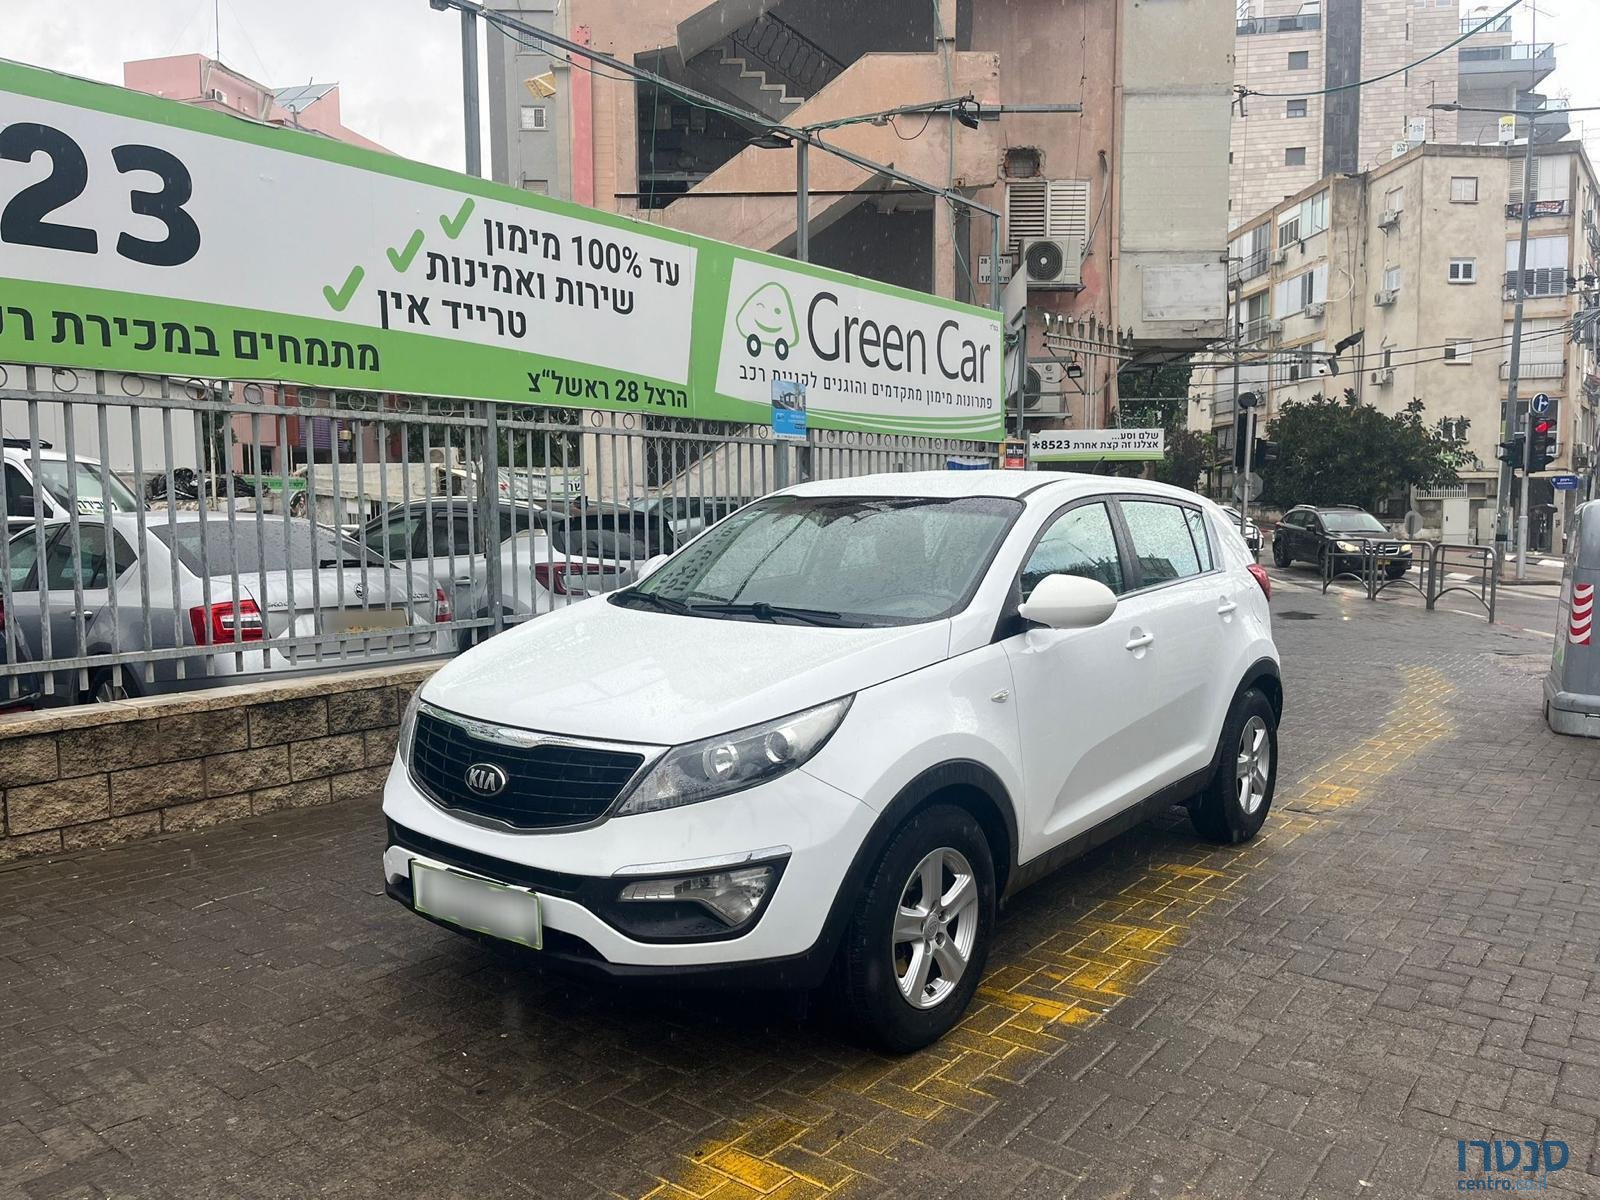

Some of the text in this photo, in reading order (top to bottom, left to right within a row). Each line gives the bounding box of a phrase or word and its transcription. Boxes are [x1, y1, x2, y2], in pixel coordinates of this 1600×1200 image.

[0, 122, 201, 267] 23
[483, 218, 680, 287] עד 100% מימון
[426, 251, 634, 315] שירות ואמינות
[377, 289, 527, 339] טרייד אין
[51, 310, 220, 357] במכירת
[807, 291, 991, 384] Green Car
[233, 329, 380, 372] מתמחים
[739, 364, 766, 382] רכב
[615, 378, 639, 403] 28
[644, 381, 688, 408] הרצל
[823, 376, 867, 395] והוגנים
[872, 383, 922, 402] מתקדמים
[926, 389, 953, 405] מימון
[955, 394, 993, 409] פתרונות
[1072, 442, 1098, 450] אחרת
[1100, 441, 1119, 450] קצת
[1121, 441, 1131, 449] זה
[1133, 440, 1159, 449] אצלנו
[1138, 431, 1159, 440] שלם
[468, 768, 496, 792] KIA
